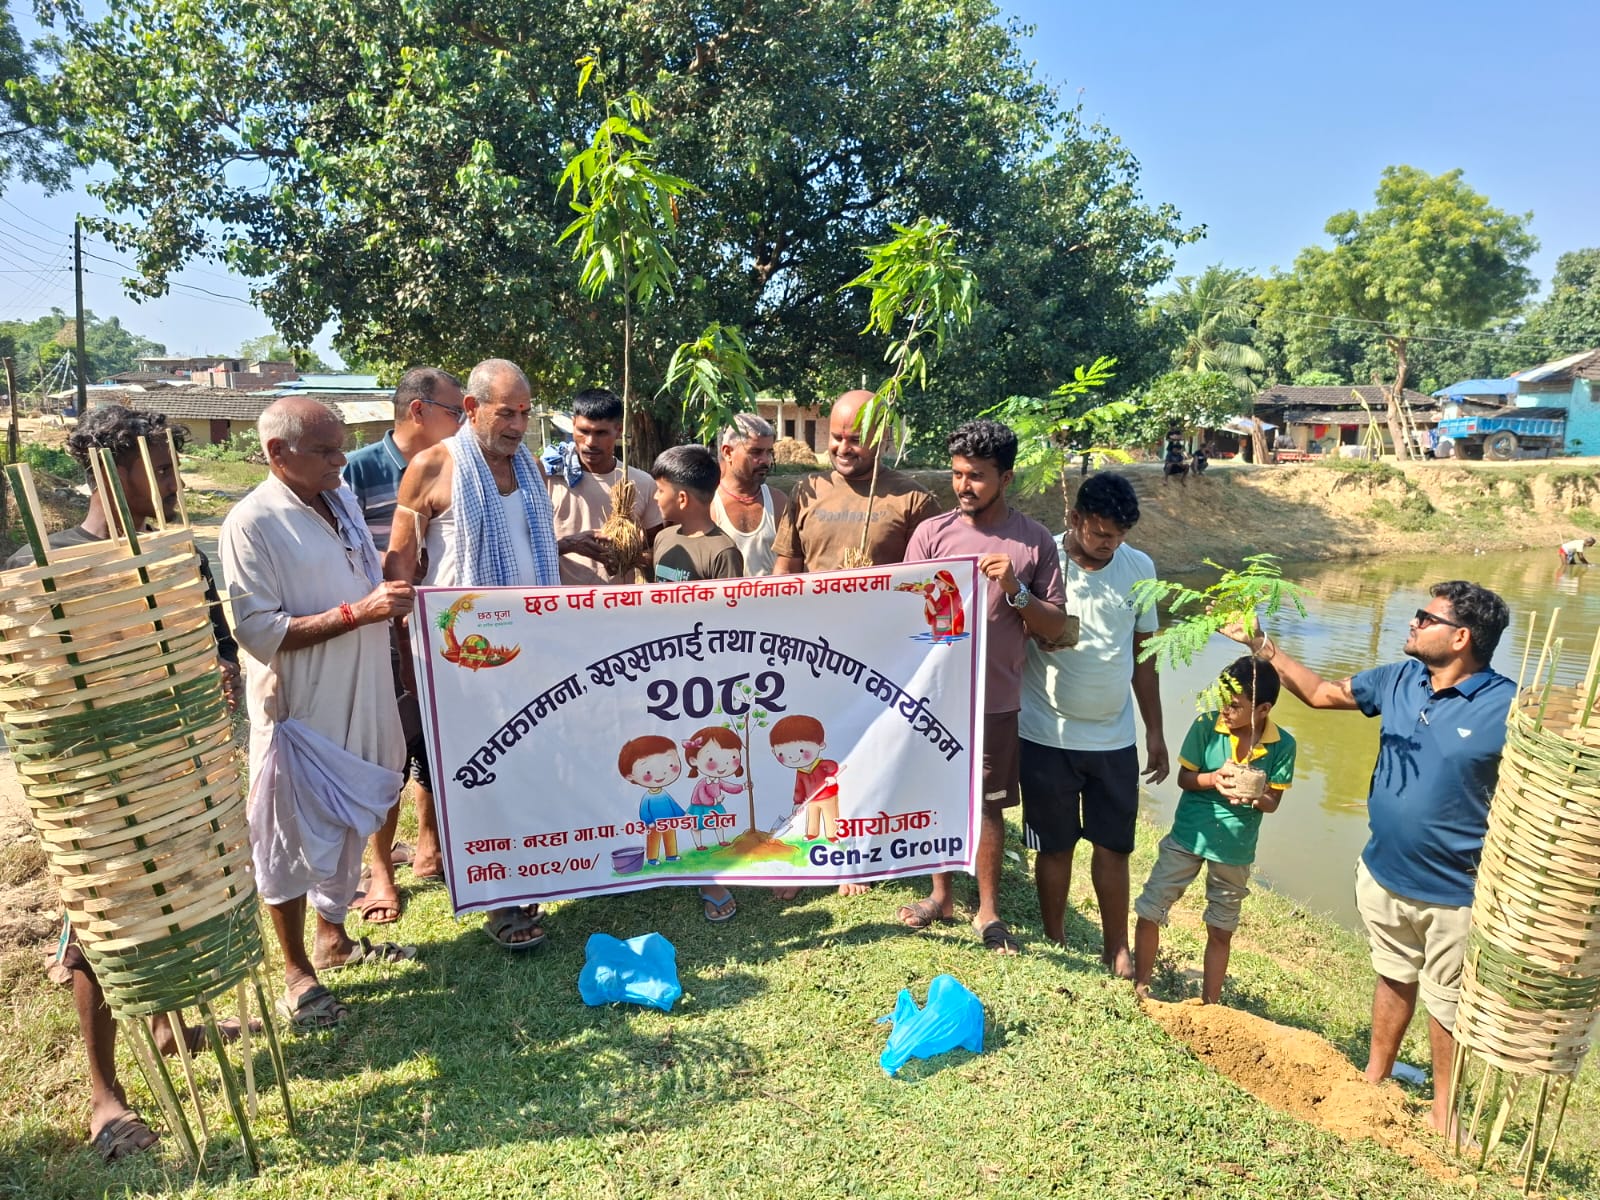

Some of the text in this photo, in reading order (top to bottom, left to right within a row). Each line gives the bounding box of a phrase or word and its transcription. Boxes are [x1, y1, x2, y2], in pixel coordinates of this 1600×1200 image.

[566, 589, 598, 610] पर्व
[602, 591, 643, 609] तथा
[650, 585, 717, 604] कार्तिक
[723, 577, 806, 608] पुर्णिमाको
[812, 574, 892, 594] अवसरमा
[452, 673, 588, 789] शुभकामना,
[706, 629, 756, 654] तथा
[759, 635, 867, 685] वृक्षारोपण
[865, 669, 964, 762] कार्यक्रम
[646, 671, 787, 721] २०८२
[522, 831, 568, 848] नरहा
[655, 815, 699, 832] डण्डा
[703, 810, 737, 828] टोल
[518, 853, 600, 877] २०८२/०७/
[809, 836, 963, 866] Gen-z Group
